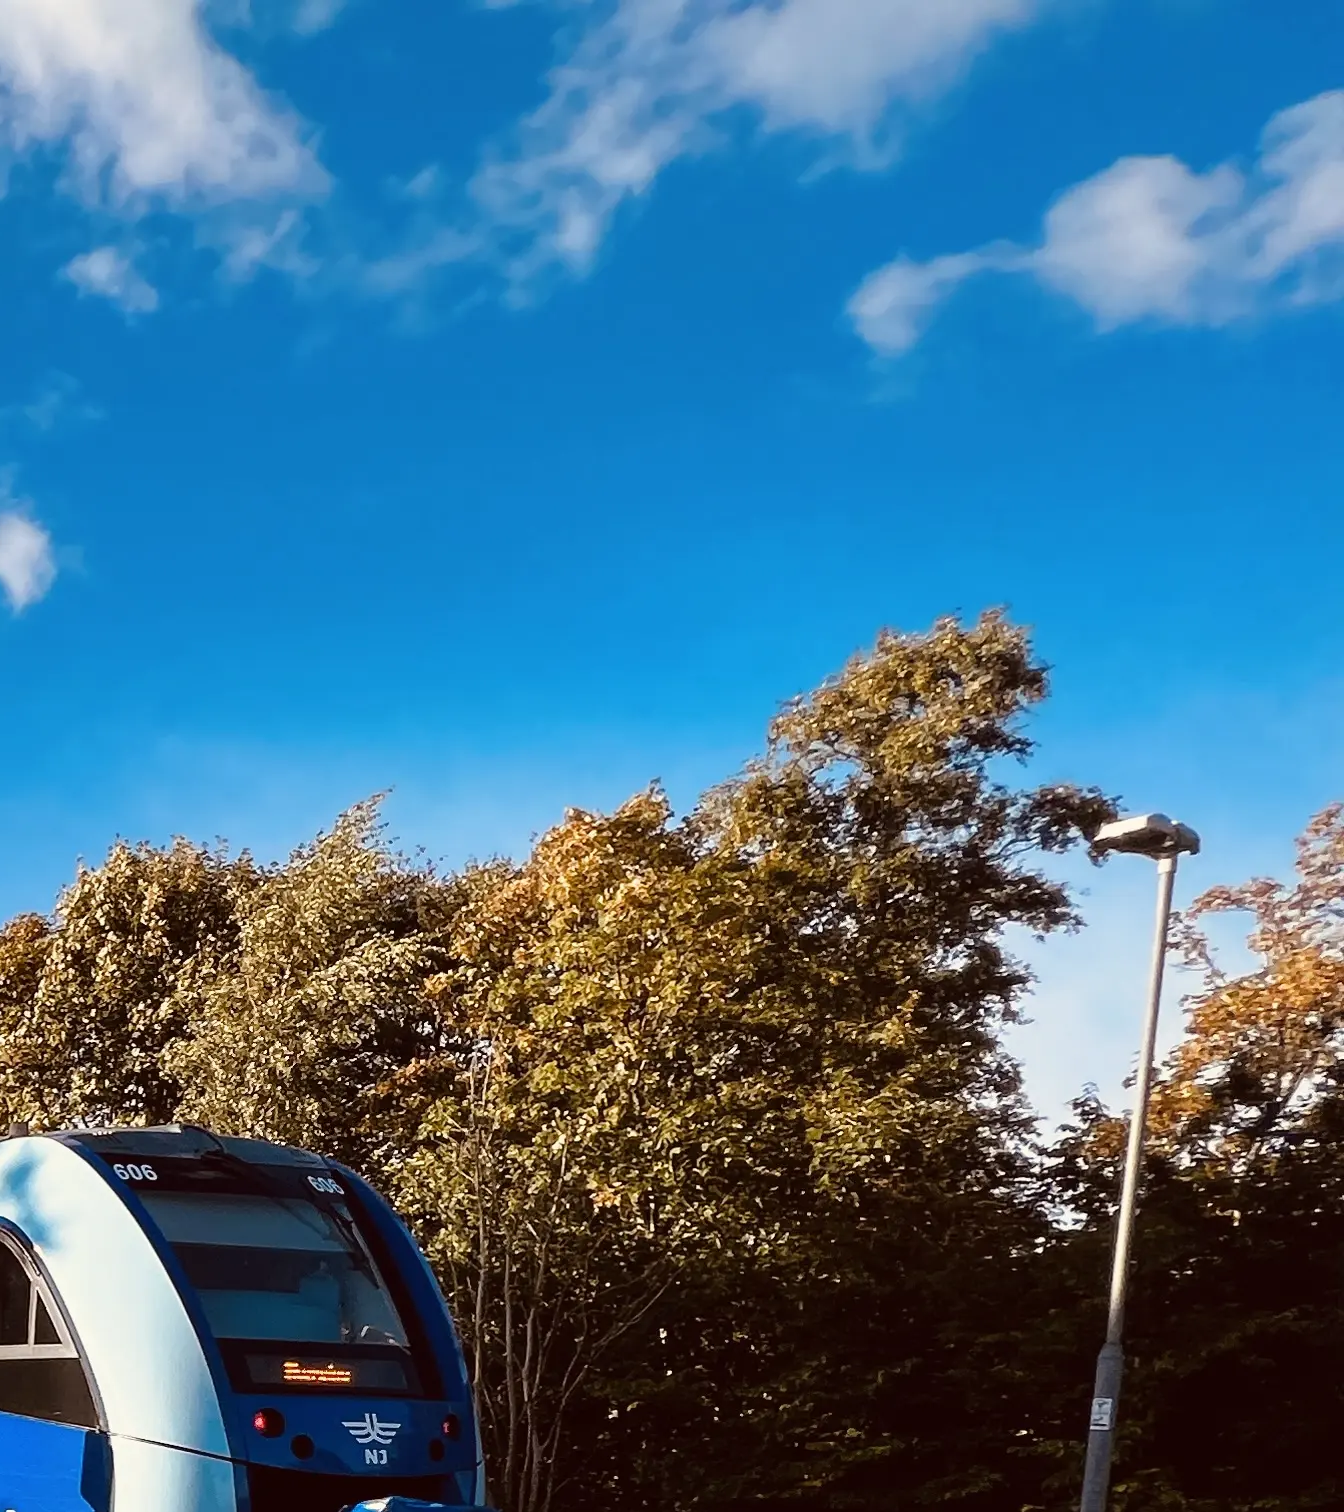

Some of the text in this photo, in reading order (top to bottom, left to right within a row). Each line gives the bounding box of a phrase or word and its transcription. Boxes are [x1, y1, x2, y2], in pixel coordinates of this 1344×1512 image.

[113, 1163, 158, 1181] 606
[308, 1175, 345, 1195] 606
[364, 1448, 388, 1465] NJ
